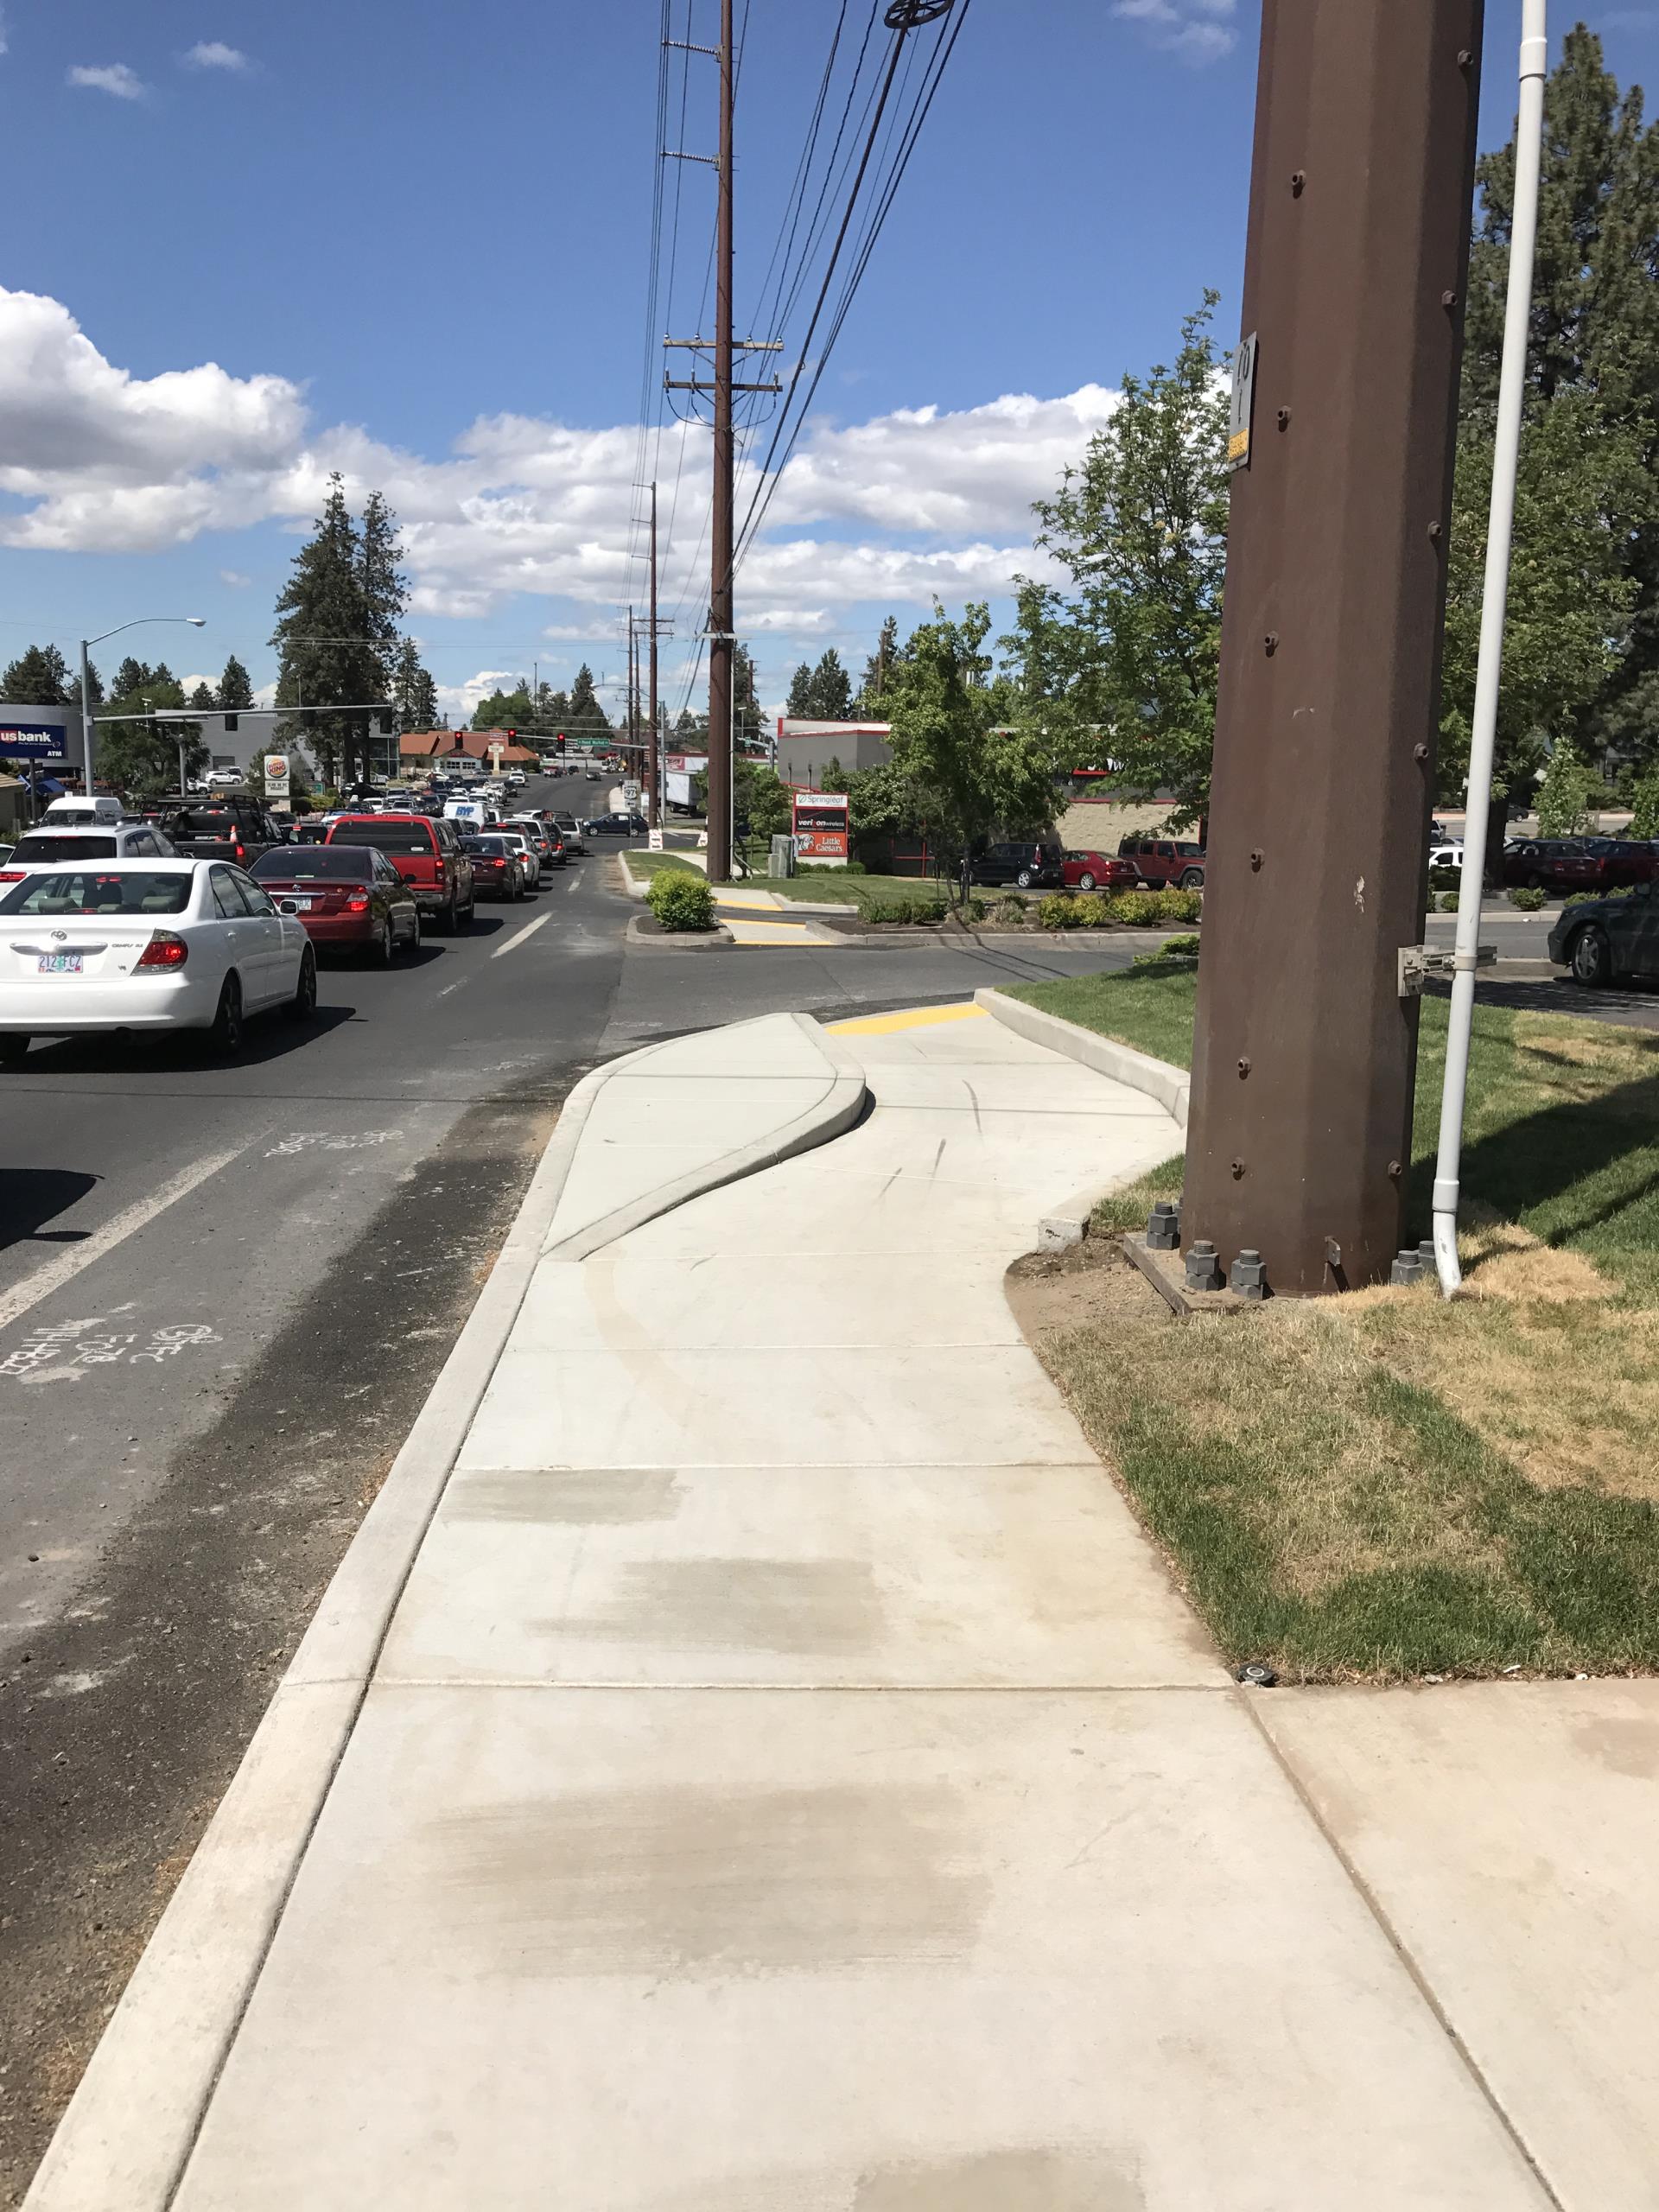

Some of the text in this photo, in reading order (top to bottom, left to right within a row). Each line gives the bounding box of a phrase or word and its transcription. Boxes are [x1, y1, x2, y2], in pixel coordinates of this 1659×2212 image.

[807, 796, 843, 804] Springleaf
[822, 836, 841, 845] Little
[816, 843, 843, 852] Caesars
[40, 956, 82, 968] 212 FCZ
